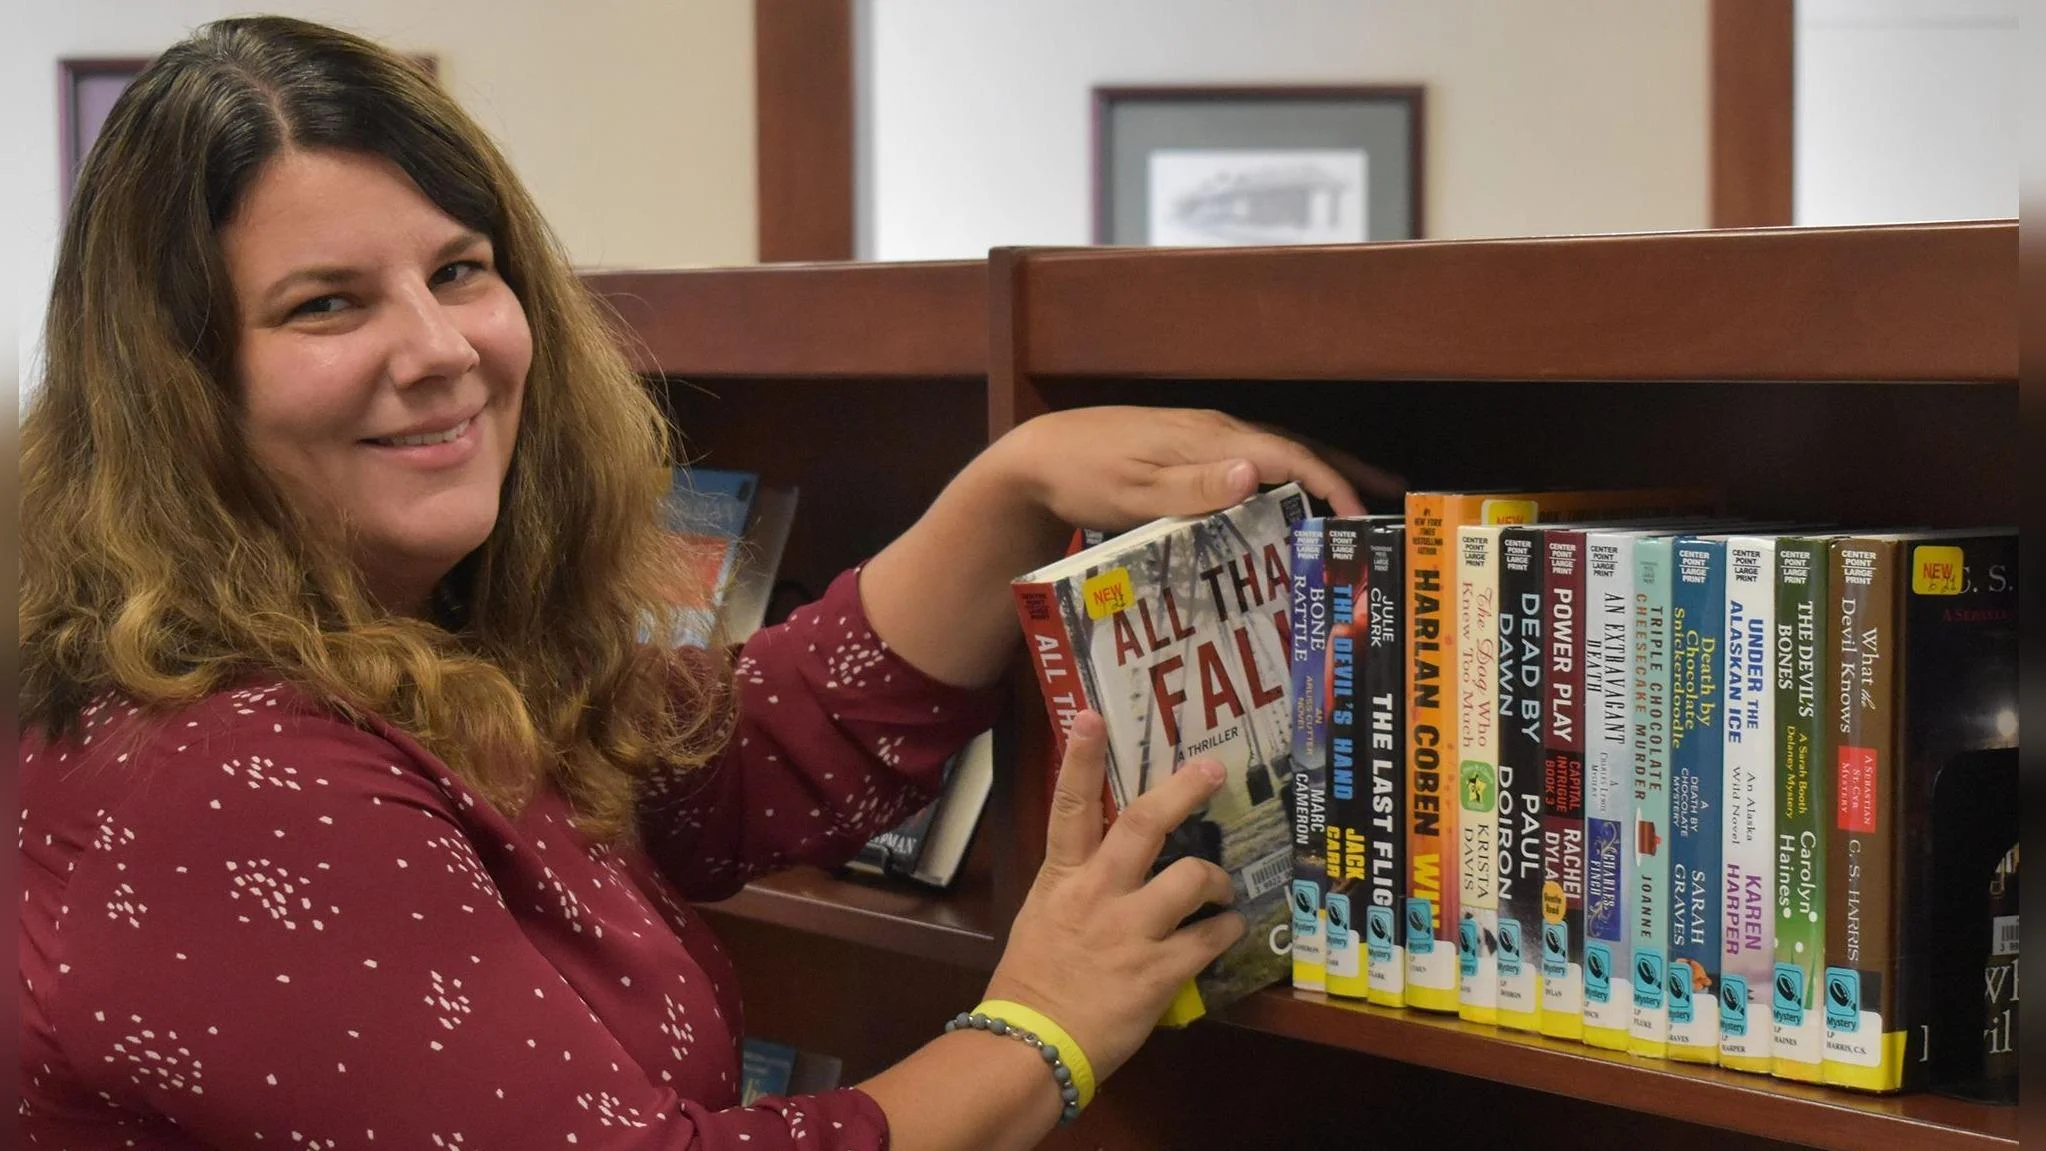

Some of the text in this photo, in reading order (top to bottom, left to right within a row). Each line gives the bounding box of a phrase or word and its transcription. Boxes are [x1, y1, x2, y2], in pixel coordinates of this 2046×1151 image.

[1329, 530, 1357, 538] CENTER
[1332, 537, 1354, 545] POINT
[1462, 536, 1488, 544] CENTER
[1504, 539, 1532, 548] CENTER
[1506, 556, 1530, 564] LARGE
[1507, 547, 1529, 555] POINT
[1549, 543, 1576, 551] CENTER
[1552, 550, 1572, 558] POINT
[1590, 545, 1618, 554] CENTER
[1593, 553, 1613, 561] POINT
[1679, 550, 1710, 559] CENTER
[1732, 549, 1761, 557] CENTER
[1780, 551, 1810, 559] CENTER
[1841, 550, 1876, 559] CENTER
[1465, 559, 1485, 567] PRINT
[1507, 563, 1528, 571] PRINT
[1592, 562, 1616, 570] LARGE
[1593, 569, 1614, 577] PRINT
[1681, 568, 1707, 576] LARGE
[1682, 558, 1706, 566] POINT
[1682, 575, 1706, 583] PRINT
[1736, 574, 1757, 582] PRINT
[1783, 569, 1808, 577] LARGE
[1784, 576, 1806, 584] PRINT
[1844, 569, 1873, 577] LARGE
[1845, 558, 1873, 567] POINT
[1845, 576, 1872, 585] PRINT
[1923, 563, 1954, 580] NEW
[1093, 582, 1124, 605] NEW
[1113, 536, 1292, 667] ALL THA
[1294, 575, 1307, 662] RATTLE
[1310, 587, 1325, 651] BONE
[1371, 588, 1382, 648] CLARK
[1382, 596, 1394, 643] JULIE
[1034, 634, 1067, 684] ALL
[1413, 569, 1440, 709] HARLAN
[1462, 581, 1474, 748] Knew Too Much
[1499, 613, 1514, 717] DAWN
[1553, 588, 1573, 743] POWER PLAY
[1587, 640, 1602, 692] DEATH
[1778, 624, 1793, 690] BONES
[1798, 601, 1814, 719] THE DEVIL'S
[1840, 597, 1857, 733] Devil Knows
[1333, 585, 1354, 800] THE DEVIL'S HAND
[1474, 587, 1494, 747] The Dog Who
[1521, 594, 1540, 744] DEAD BY
[1604, 592, 1625, 744] AN EXTRAVAGANT
[1672, 607, 1685, 749] Snickerdoodle
[1685, 630, 1699, 729] Chocolate
[1697, 637, 1716, 726] Death by
[1728, 600, 1743, 744] ALASKAN ICE
[1747, 619, 1763, 729] UNDER THE
[1861, 627, 1879, 710] What the
[1315, 708, 1323, 725] AN
[1634, 593, 1648, 800] CHEESECAKE MURDER
[1649, 606, 1663, 791] TRIPLE CHOCOLATE
[1187, 726, 1239, 758] THRILLER
[1306, 714, 1314, 756] CUTTER
[1372, 693, 1393, 906] THE LAST FLIG
[1414, 724, 1440, 836] COBEN
[1545, 761, 1555, 805] BOOK 3
[1556, 755, 1567, 813] INTRIGUE
[1569, 761, 1581, 810] CAPITAL
[1785, 726, 1796, 819] Delaney Mystery
[1799, 733, 1808, 814] A Sarah Booth
[1841, 763, 1850, 813] MYSTERY
[1852, 789, 1860, 808] CYR
[1864, 755, 1873, 825] A SEBASTIAN
[1295, 773, 1309, 844] CAMERON
[1311, 789, 1325, 833] MARC
[1680, 767, 1689, 838] CHOCOLATE
[1690, 776, 1698, 832] DEATH BY
[1700, 801, 1709, 809] A
[1731, 766, 1741, 845] Wild Novel
[1746, 772, 1756, 841] An Alaska
[1327, 826, 1341, 878] CARR
[1345, 828, 1366, 880] JACK
[1464, 828, 1474, 890] DAVIS
[1498, 765, 1514, 900] DOIRON
[1520, 794, 1540, 878] PAUL
[1544, 831, 1559, 881] DYLA
[1477, 824, 1490, 899] KRISTA
[1563, 828, 1581, 899] RACHEL
[1591, 860, 1601, 897] FINCH
[1779, 834, 1795, 906] Haines
[1797, 830, 1816, 914] Carolyn
[1641, 875, 1651, 938] JOANNE
[1674, 863, 1686, 946] GRAVES
[1691, 870, 1706, 945] SARAH
[1726, 864, 1740, 955] HARPER
[1745, 875, 1762, 950] KAREN
[1848, 890, 1860, 961] HARRIS
[1774, 1010, 1800, 1024] Mystery
[1826, 1016, 1856, 1030] Mystery
